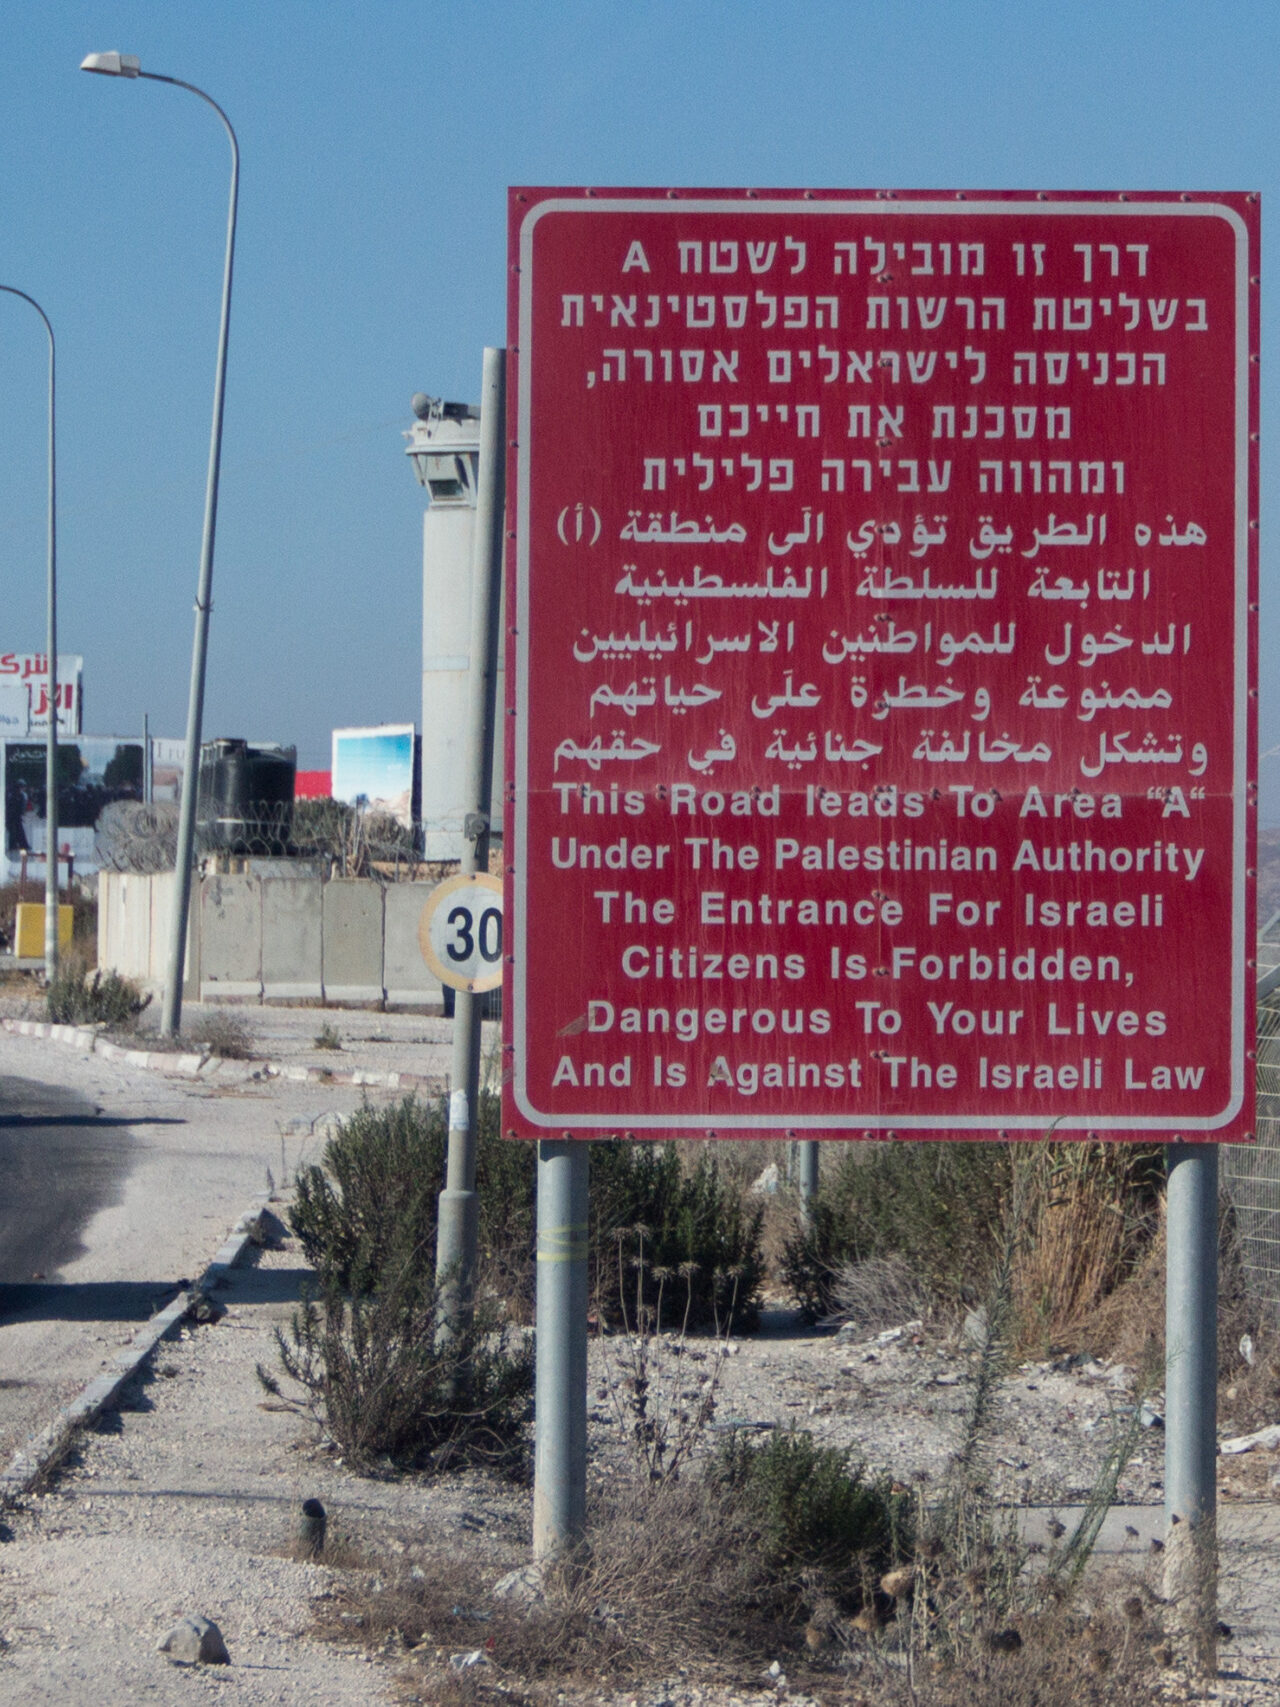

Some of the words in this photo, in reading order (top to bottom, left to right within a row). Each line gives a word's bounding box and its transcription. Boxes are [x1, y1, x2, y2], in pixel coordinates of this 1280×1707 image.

[622, 241, 651, 273] A
[678, 236, 806, 275] לשטח
[835, 236, 984, 276] מובילה
[1013, 244, 1045, 276] זו
[1074, 244, 1149, 283] דרך
[561, 289, 839, 329] הפלסטינאית
[867, 296, 1005, 330] הרשות
[1034, 293, 1209, 331] בשליטת
[586, 349, 739, 389] אסורה,
[767, 345, 986, 384] לישראלים
[1014, 351, 1166, 385] הכניסה
[698, 404, 820, 438] חייכם
[848, 405, 904, 438] את
[933, 405, 1071, 440] מסכנת
[643, 453, 794, 492] פלילית
[822, 459, 952, 493] עבירה
[980, 460, 1124, 494] ומהווה
[620, 509, 748, 543] منطقة
[847, 514, 948, 558] تؤدي
[970, 513, 1107, 559] الطريق
[1135, 514, 1208, 547] هذه
[614, 564, 828, 606] الفلسطينية
[855, 567, 998, 600] للسلطة
[1027, 568, 1150, 609] التابعة
[573, 620, 794, 665] الاسرائيليين
[822, 620, 1016, 666] للمواطنين
[1045, 622, 1191, 667] الدخول
[589, 675, 723, 719] حياتهم
[851, 675, 991, 721] وخطرة
[1019, 675, 1173, 722] ممنوعة
[553, 730, 662, 773] حقهم
[687, 729, 737, 776] في
[764, 729, 883, 770] جنائية
[912, 729, 1053, 763] مخالفة
[1080, 731, 1208, 778] وتشكل
[552, 782, 646, 816] This
[670, 783, 781, 816] Road
[806, 783, 925, 818] leads
[949, 784, 997, 817] To
[1020, 784, 1122, 819] Area
[552, 837, 670, 870] Under
[684, 837, 760, 870] The
[776, 838, 997, 871] Palestinian
[1012, 839, 1205, 881] Authority
[594, 891, 675, 925] The
[701, 892, 903, 926] Entrance
[930, 893, 1001, 927] For
[1025, 893, 1163, 927] Israeli
[447, 906, 503, 963] 30
[622, 945, 806, 980] Citizens
[832, 947, 868, 980] Is
[893, 947, 1135, 987] Forbidden,
[588, 1001, 831, 1042] Dangerous
[856, 1001, 902, 1035] To
[926, 1002, 1024, 1035] Your
[1048, 1002, 1167, 1036] Lives
[552, 1055, 631, 1087] And
[654, 1055, 687, 1088] Is
[707, 1055, 862, 1096] Against
[883, 1057, 958, 1089] The
[980, 1057, 1102, 1090] Israeli
[1126, 1058, 1205, 1090] Law
